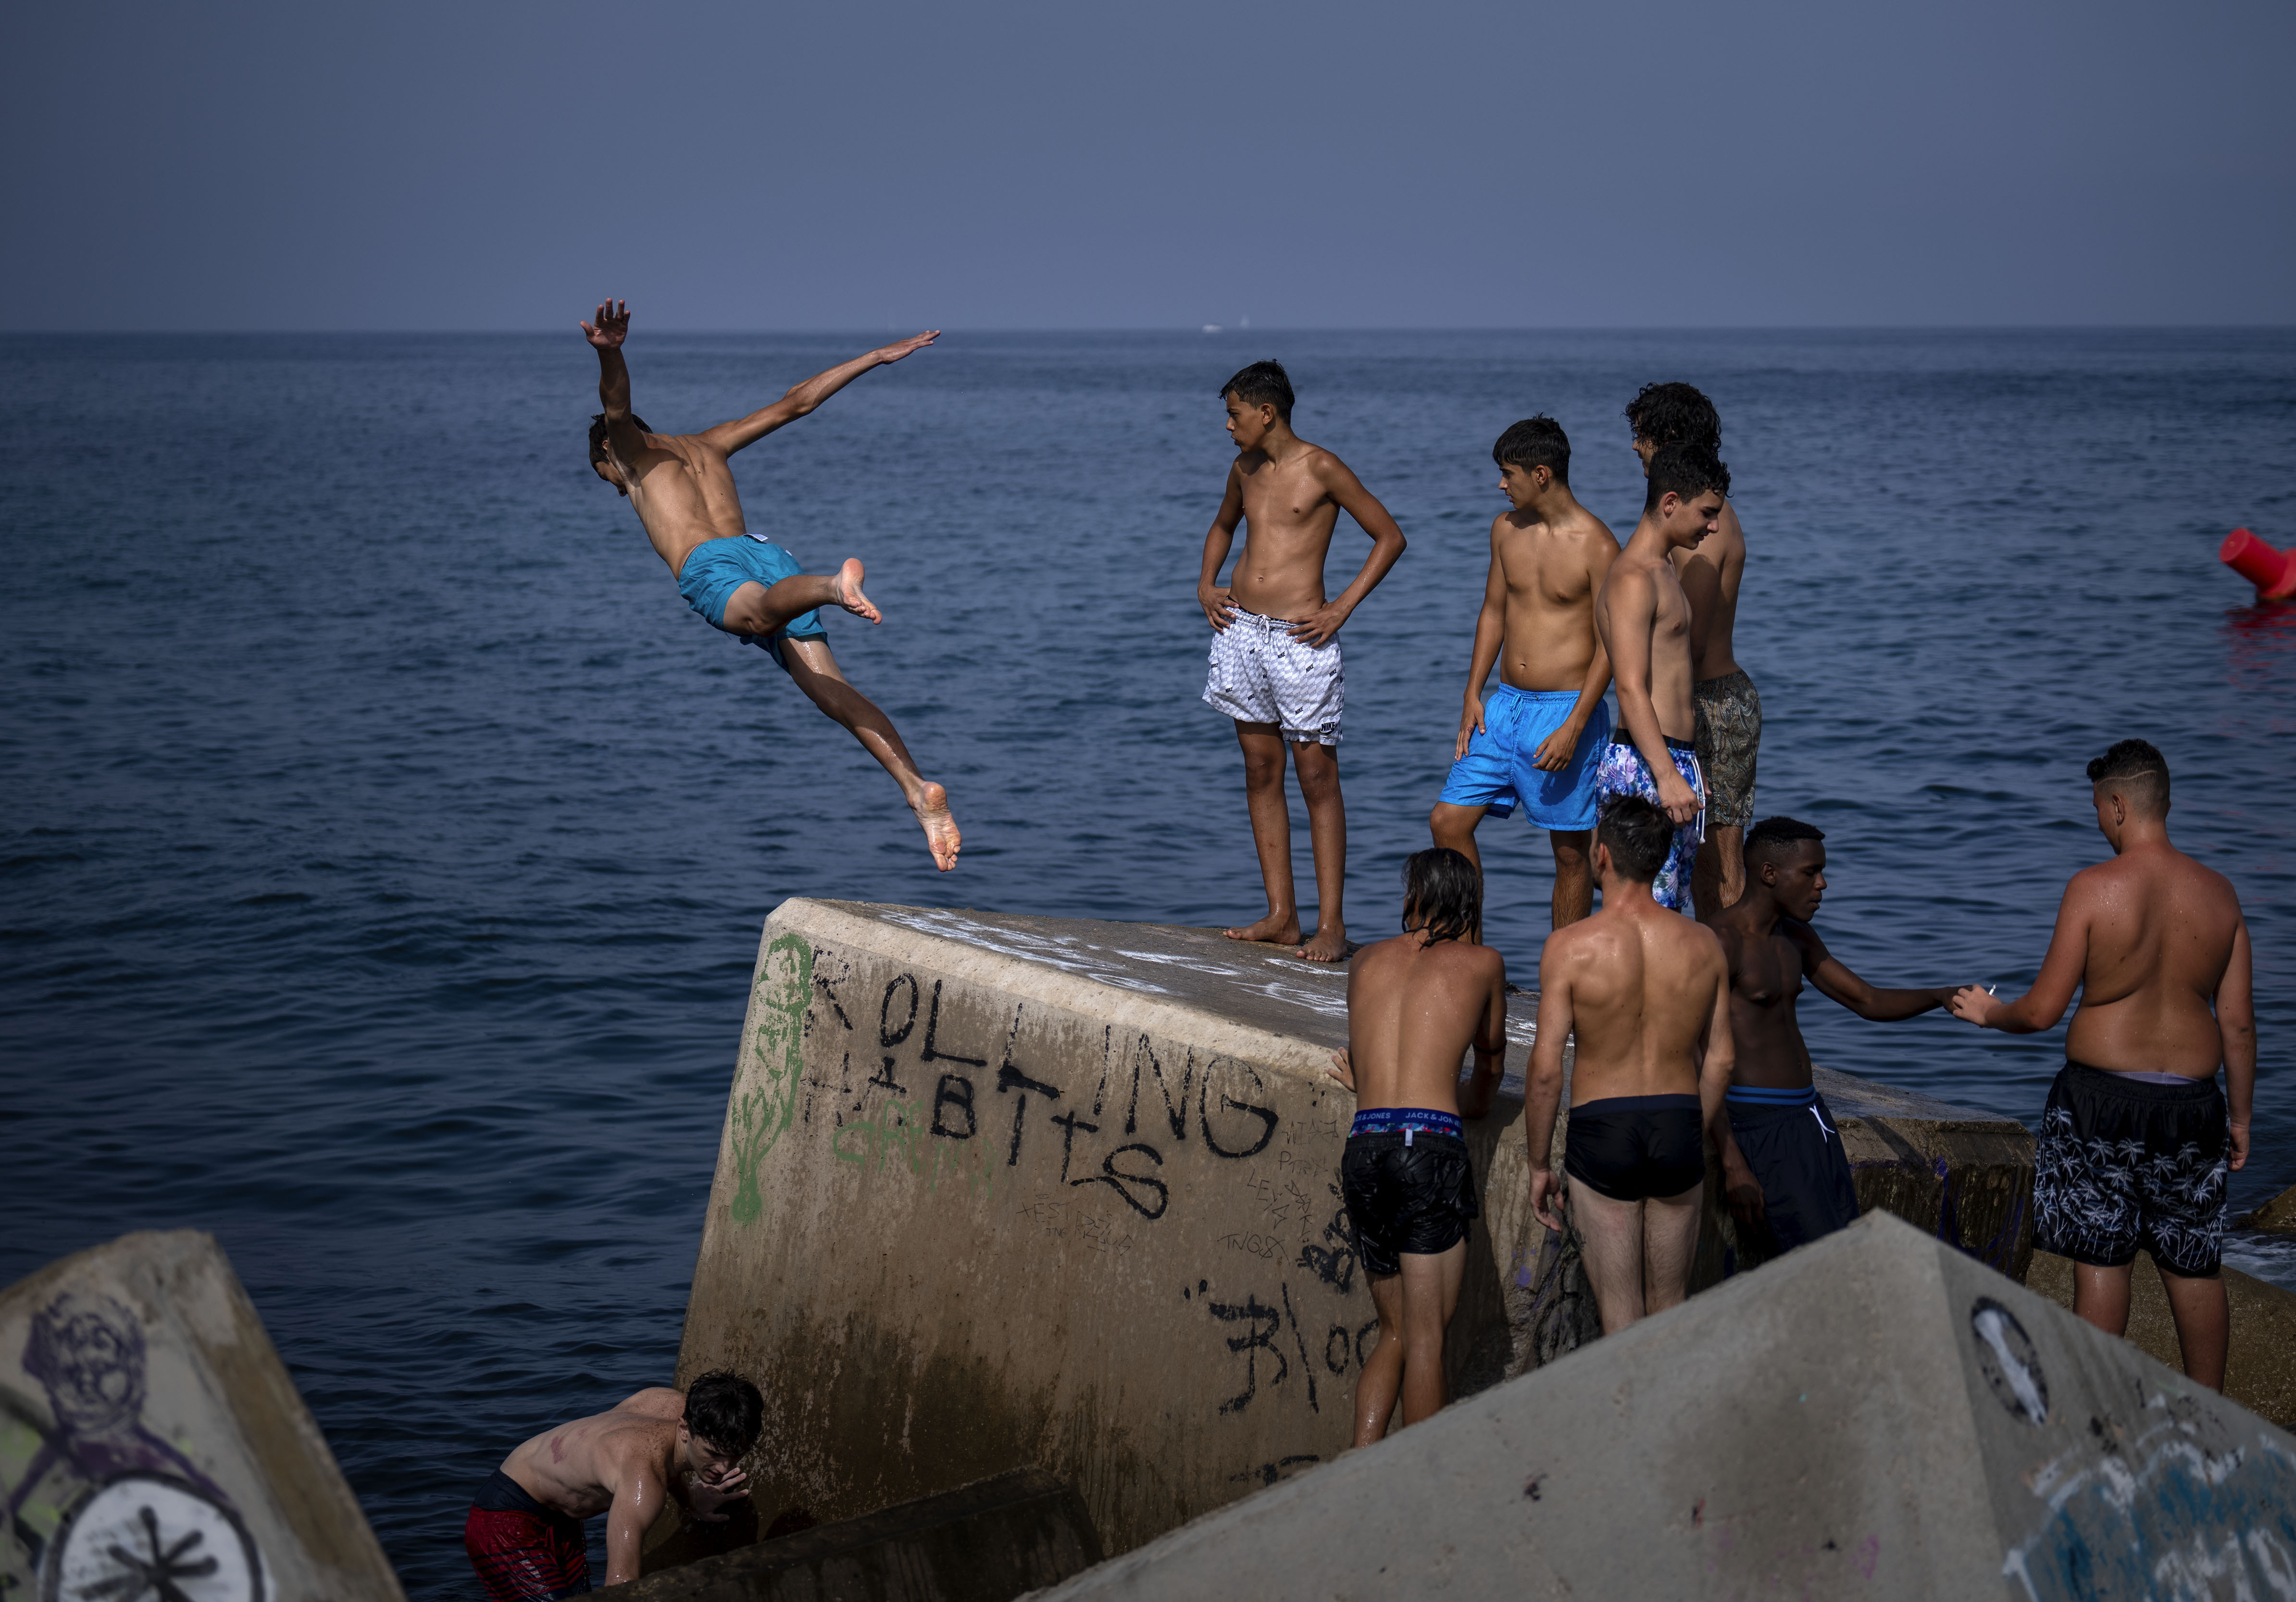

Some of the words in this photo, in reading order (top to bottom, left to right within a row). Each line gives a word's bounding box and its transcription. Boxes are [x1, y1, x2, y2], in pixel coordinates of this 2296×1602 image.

[1306, 663, 1314, 673] NIKE
[1295, 706, 1303, 715] NIKE
[1321, 722, 1335, 731] NIKE
[805, 945, 1278, 1158] ROLLING
